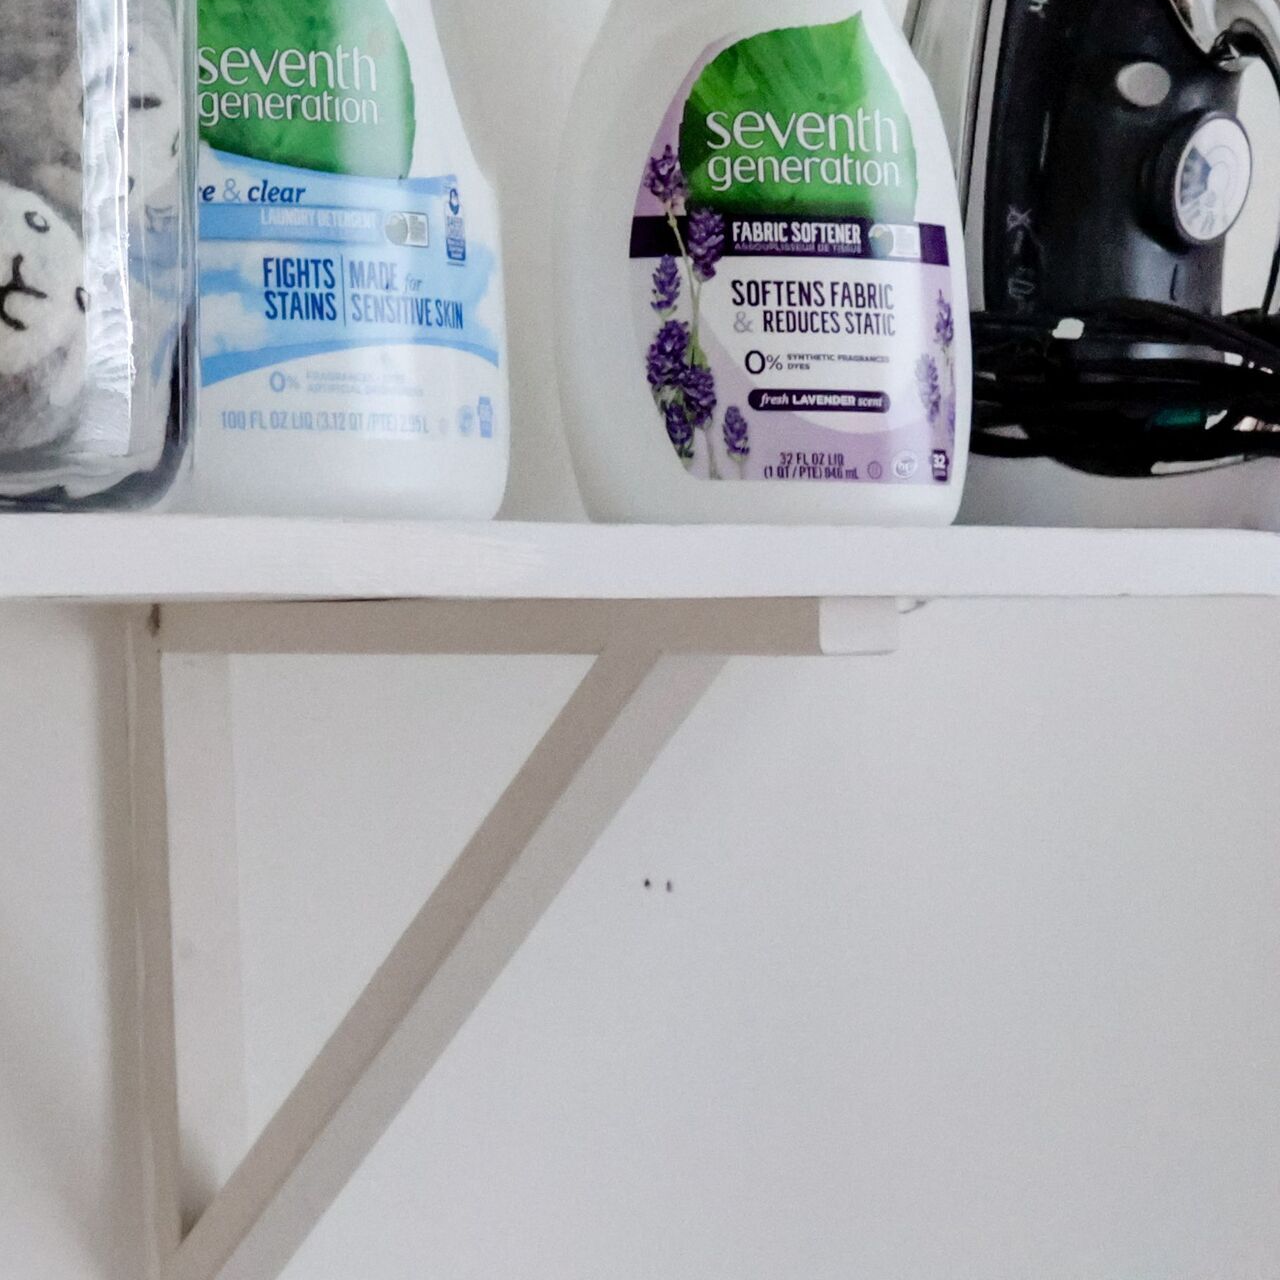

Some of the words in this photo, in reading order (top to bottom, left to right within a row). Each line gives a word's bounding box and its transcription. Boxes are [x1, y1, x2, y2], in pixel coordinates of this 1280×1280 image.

[197, 44, 378, 93] seventh
[197, 90, 379, 127] generation
[705, 107, 899, 154] seventh
[707, 153, 901, 192] generation
[222, 178, 241, 203] &
[247, 180, 307, 204] clear
[732, 221, 789, 243] FABRIC
[791, 222, 862, 245] SOFTENER
[262, 257, 336, 289] FIGHTS
[348, 260, 398, 292] MADE
[403, 273, 423, 294] for
[264, 291, 337, 321] STAINS
[730, 280, 826, 308] SOFTENS
[830, 281, 895, 310] FABRIC
[351, 292, 433, 328] SENSITIVE
[435, 298, 464, 330] SKIN
[733, 311, 755, 334] &
[762, 310, 841, 334] REDUCES
[845, 311, 896, 337] STATIC
[744, 350, 784, 375] 0%
[786, 353, 835, 362] SYNTHETIC
[787, 362, 811, 371] DYES
[759, 392, 790, 408] fresh
[791, 394, 856, 407] LAVENDER
[857, 395, 883, 408] scent
[221, 410, 246, 430] 100
[250, 410, 267, 430] FL
[270, 410, 289, 431] OZ
[779, 452, 793, 466] 32
[796, 453, 809, 466] FL
[811, 453, 825, 467] OZ
[932, 453, 946, 470] 32
